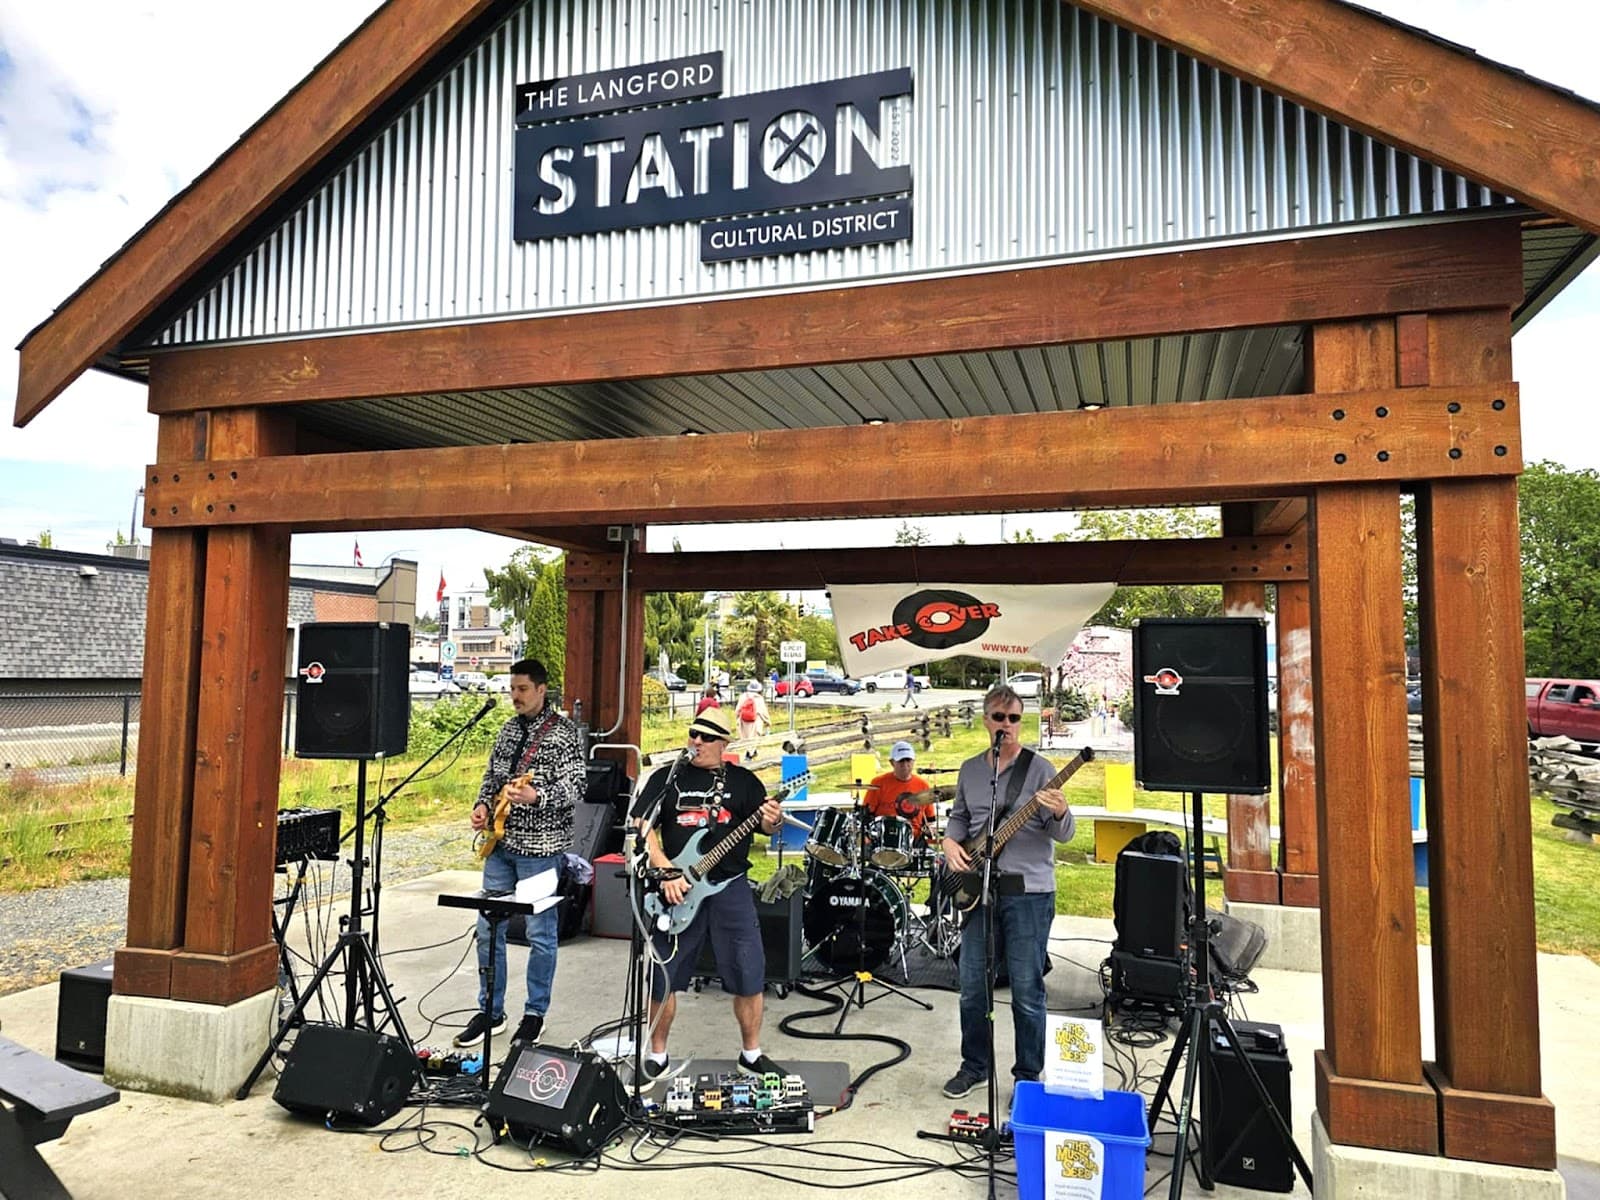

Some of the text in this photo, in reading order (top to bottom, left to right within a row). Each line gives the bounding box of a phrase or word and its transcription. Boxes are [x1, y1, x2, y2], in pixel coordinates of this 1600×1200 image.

[525, 64, 714, 111] THE LANGFORD
[534, 93, 910, 215] STATION
[710, 210, 899, 249] CULTURAL DISTRICT
[849, 602, 1002, 652] TAKE COVER
